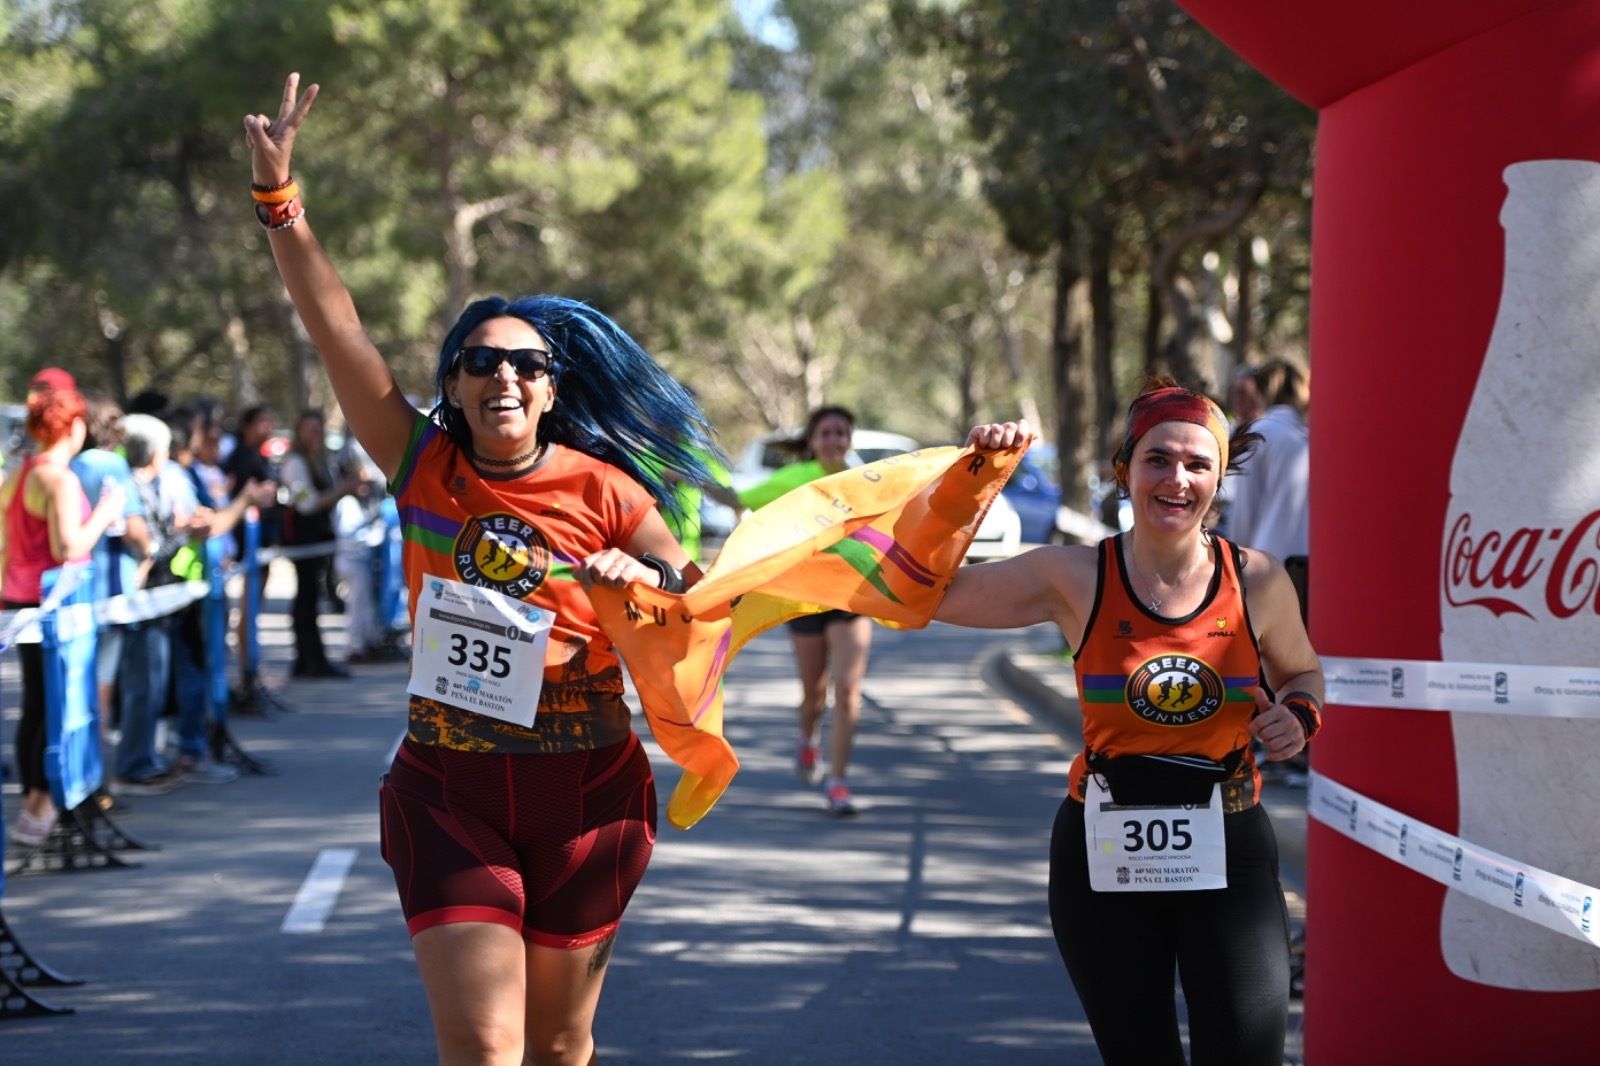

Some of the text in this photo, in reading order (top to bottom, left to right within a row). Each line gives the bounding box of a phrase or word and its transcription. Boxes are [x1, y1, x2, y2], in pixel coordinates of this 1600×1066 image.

[458, 554, 542, 596] RUNNERS
[1444, 510, 1600, 622] Coca-C
[447, 633, 512, 679] 335
[1147, 657, 1200, 674] BEER
[1133, 697, 1218, 723] RUNNERS
[1123, 818, 1193, 852] 305
